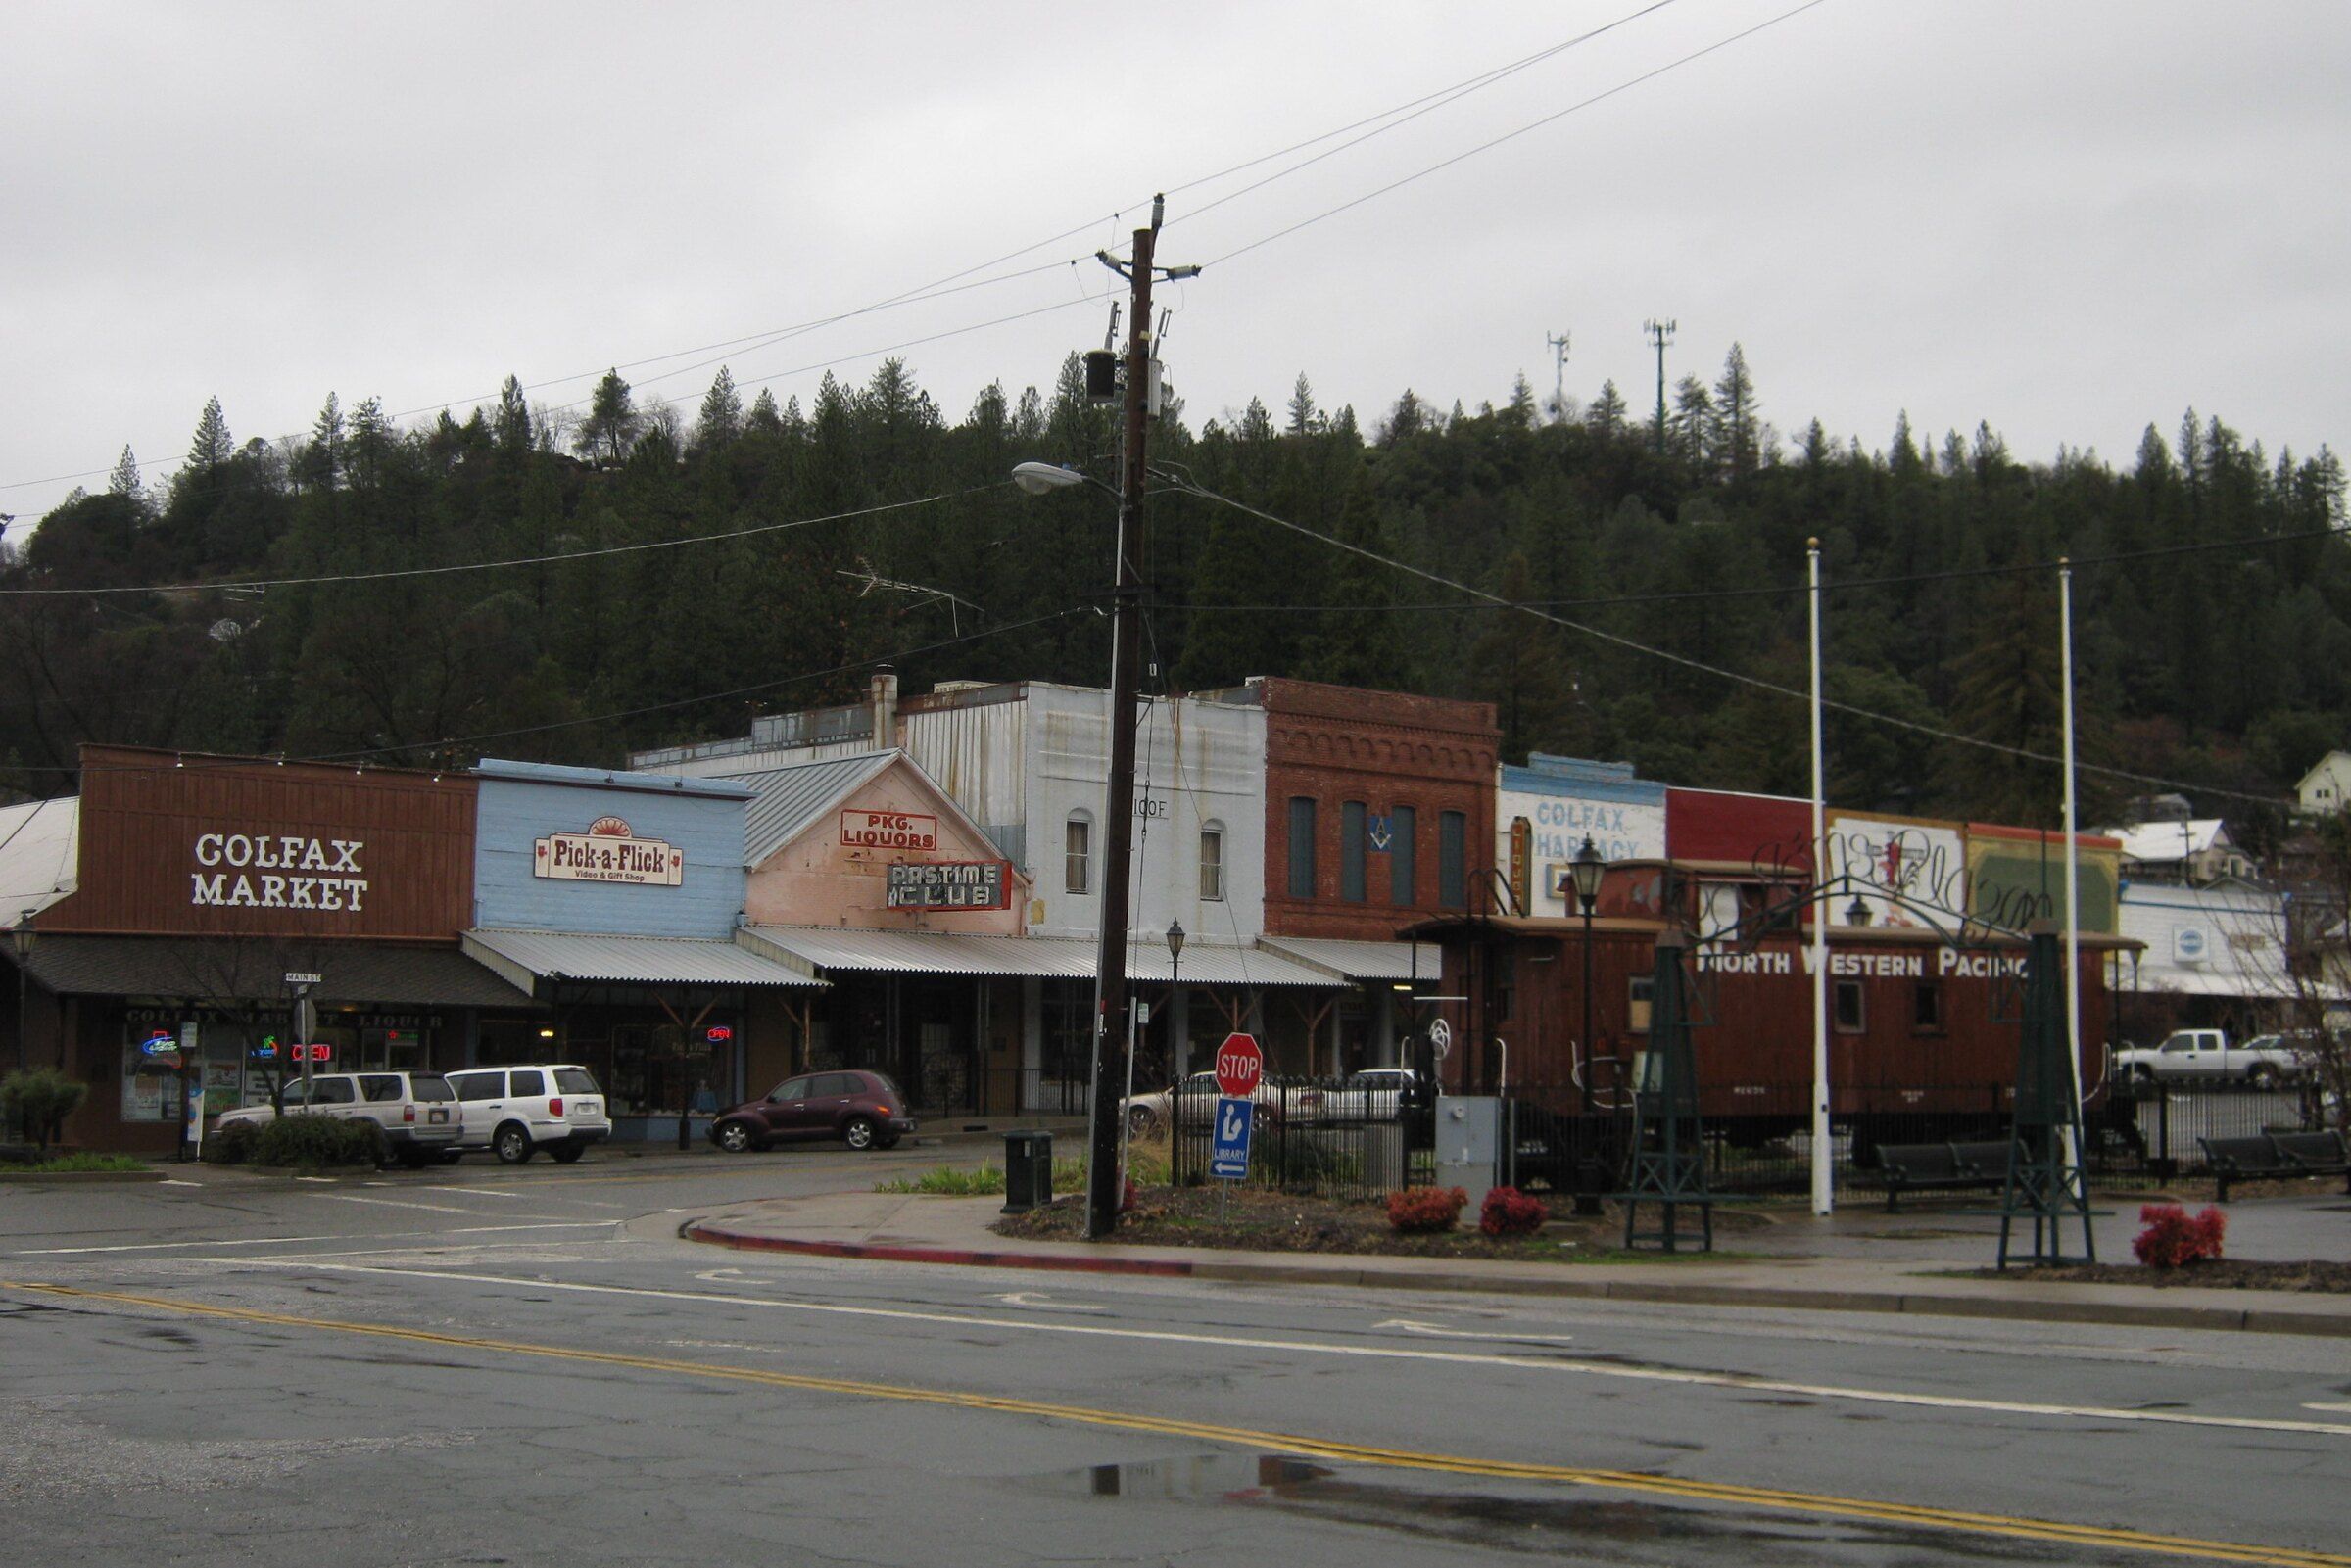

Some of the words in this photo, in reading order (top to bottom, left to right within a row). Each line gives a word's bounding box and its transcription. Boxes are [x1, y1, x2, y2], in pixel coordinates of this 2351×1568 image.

[868, 815, 913, 831] PKG.
[1536, 802, 1624, 833] COLFAX
[843, 830, 934, 848] LIQUORS
[194, 833, 364, 873] COLFAX
[554, 839, 665, 874] Pick-a-Flick
[575, 870, 599, 879] Video
[608, 873, 624, 881] Gift
[626, 873, 646, 882] Shop
[892, 865, 996, 885] PASTIME
[191, 873, 368, 912] MARKET
[899, 886, 990, 905] CLUB
[1696, 941, 1791, 974] NORTH
[1800, 945, 1923, 978] WESTERN
[287, 973, 309, 981] MAIN
[293, 1046, 330, 1060] OEN
[1219, 1055, 1258, 1080] STOP
[1213, 1148, 1245, 1162] LIBRARY
